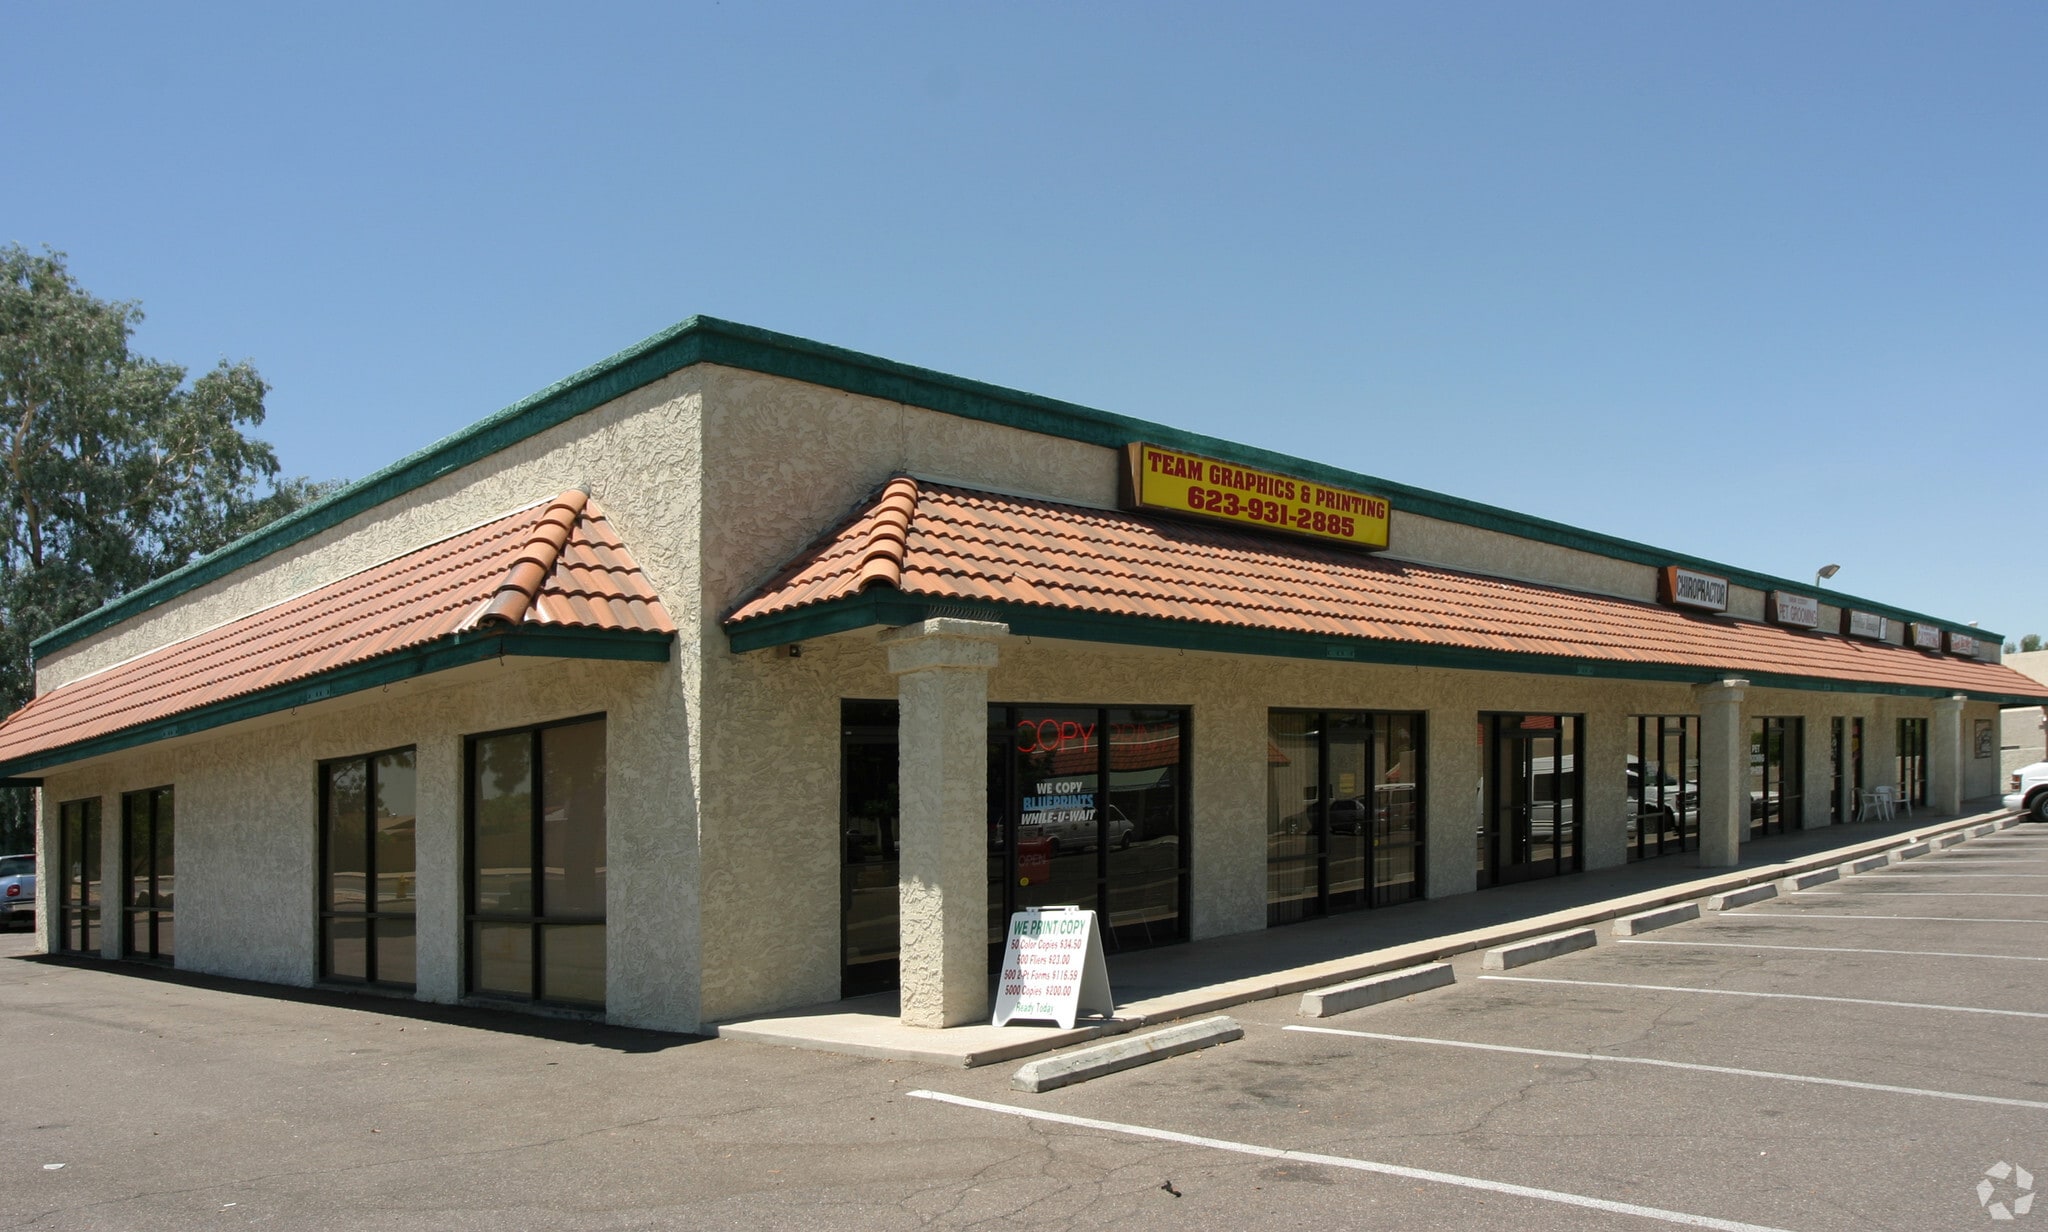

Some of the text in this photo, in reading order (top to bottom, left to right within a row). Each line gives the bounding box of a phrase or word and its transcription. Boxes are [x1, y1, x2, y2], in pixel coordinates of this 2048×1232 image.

[1148, 451, 1385, 520] TEAM GRAPHICS & PRINTING
[1187, 486, 1355, 537] 623-931-2885
[1677, 575, 1725, 605] CHIROPRACTOR
[1017, 718, 1095, 753] COPY
[1036, 781, 1083, 795] WE COPY
[1023, 794, 1094, 811] BLUEPRINTS
[1021, 809, 1096, 825] WHILE-U-WAIT
[1014, 920, 1086, 936] WE PRINT COPY
[1011, 939, 1082, 952] 50 Color Copies $34.50
[1016, 954, 1071, 965] 500 Fliers $23.00
[1004, 969, 1016, 980] 500
[1030, 970, 1050, 980] Forms
[1005, 984, 1072, 998] 5000 Copies $200.00
[1015, 1001, 1054, 1015] Ready Today
